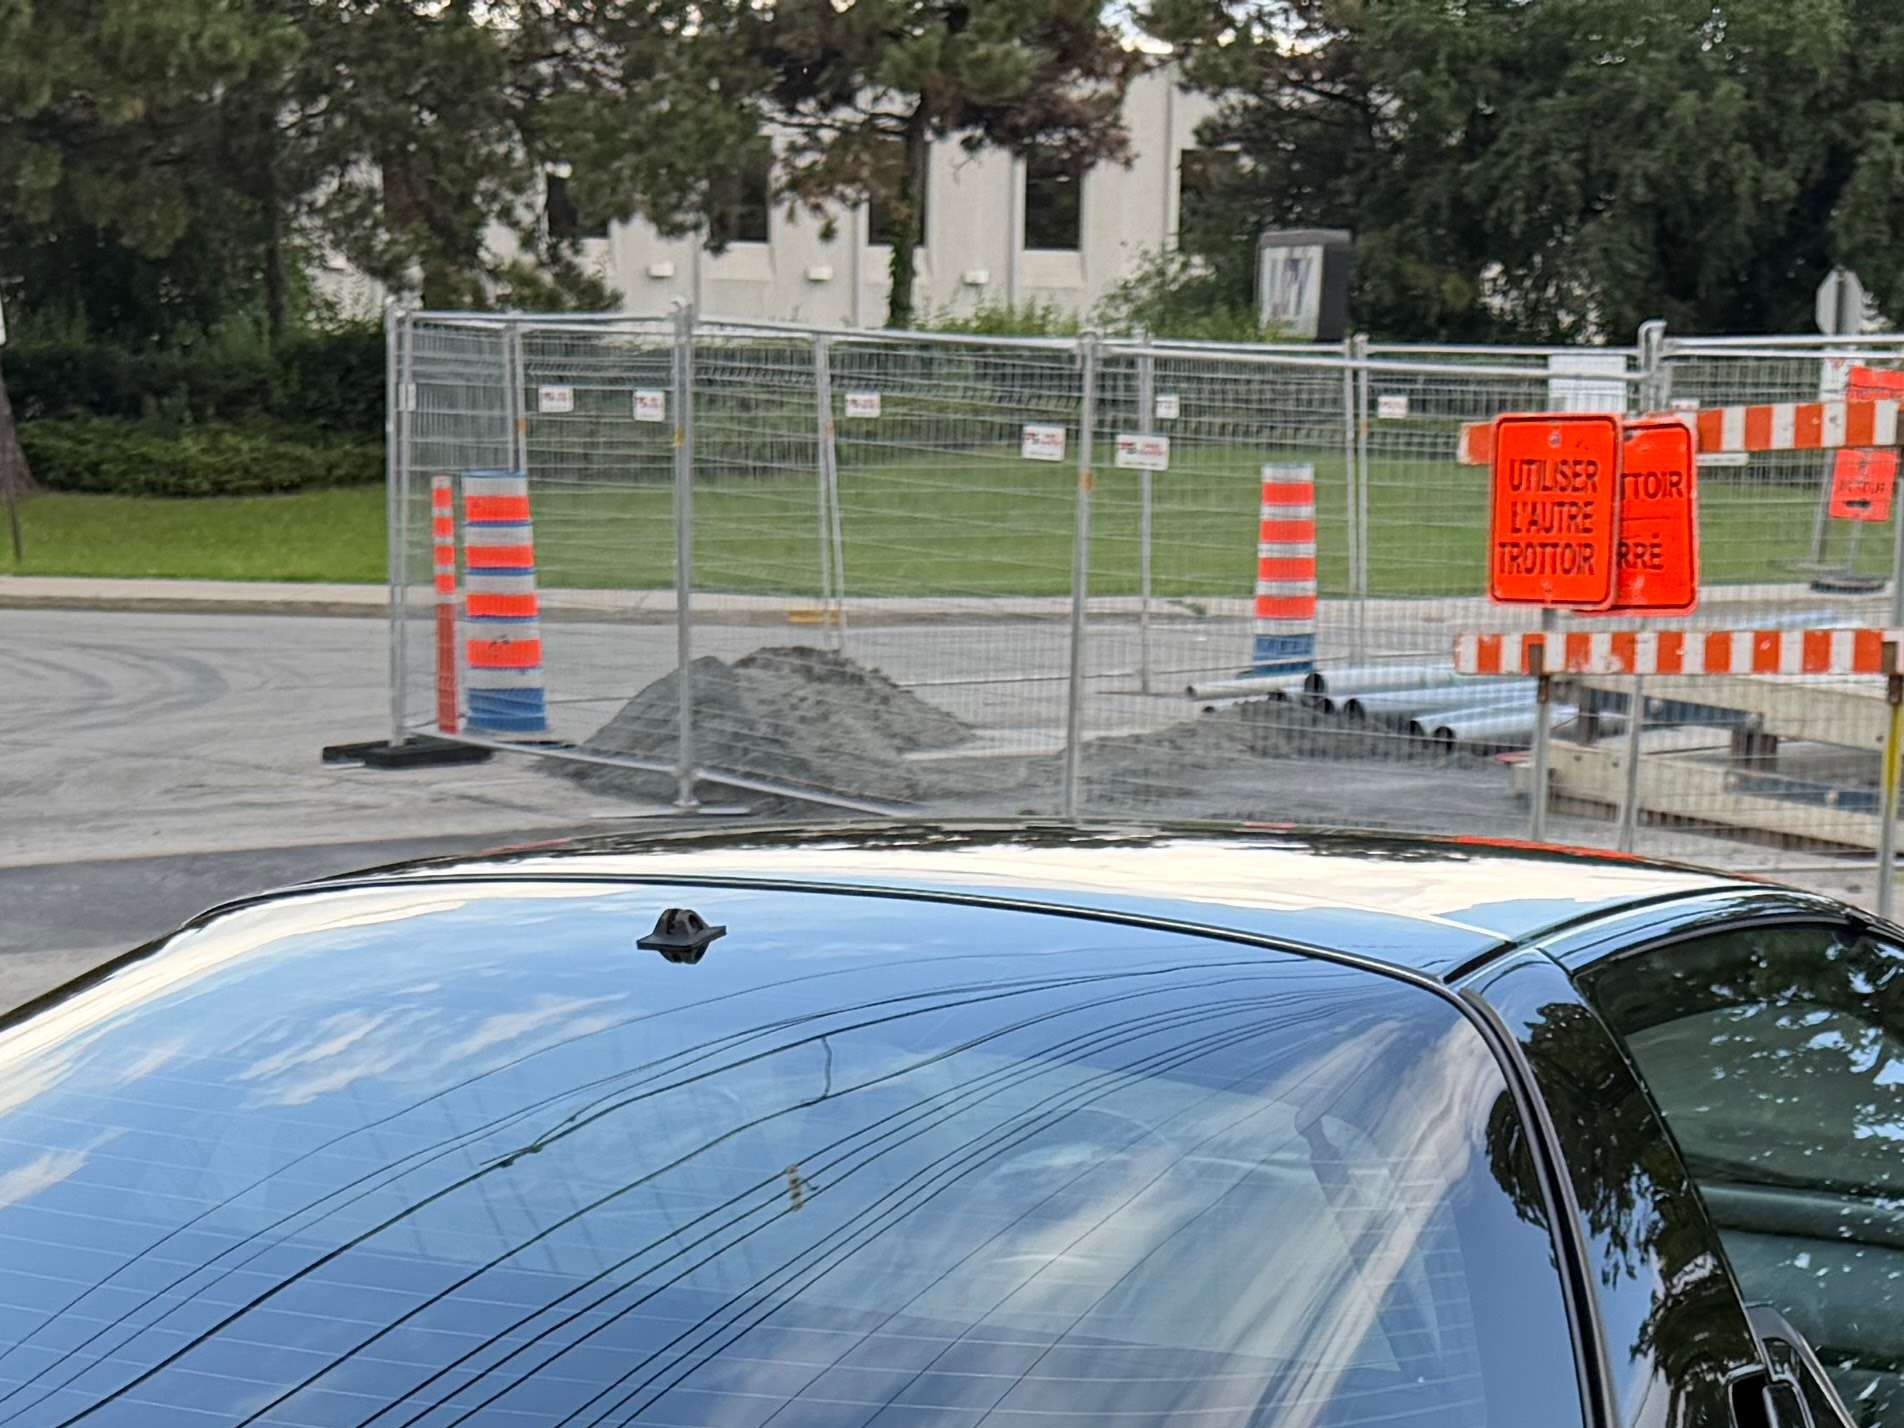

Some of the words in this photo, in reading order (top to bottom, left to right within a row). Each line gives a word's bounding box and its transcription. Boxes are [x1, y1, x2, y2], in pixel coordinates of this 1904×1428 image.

[1509, 459, 1598, 492] UTILISER
[1620, 471, 1684, 499] TTOIR
[1511, 501, 1594, 534] L'AUTRE
[1498, 542, 1596, 576] TROTTOIR
[1616, 533, 1664, 571] RRÉ
